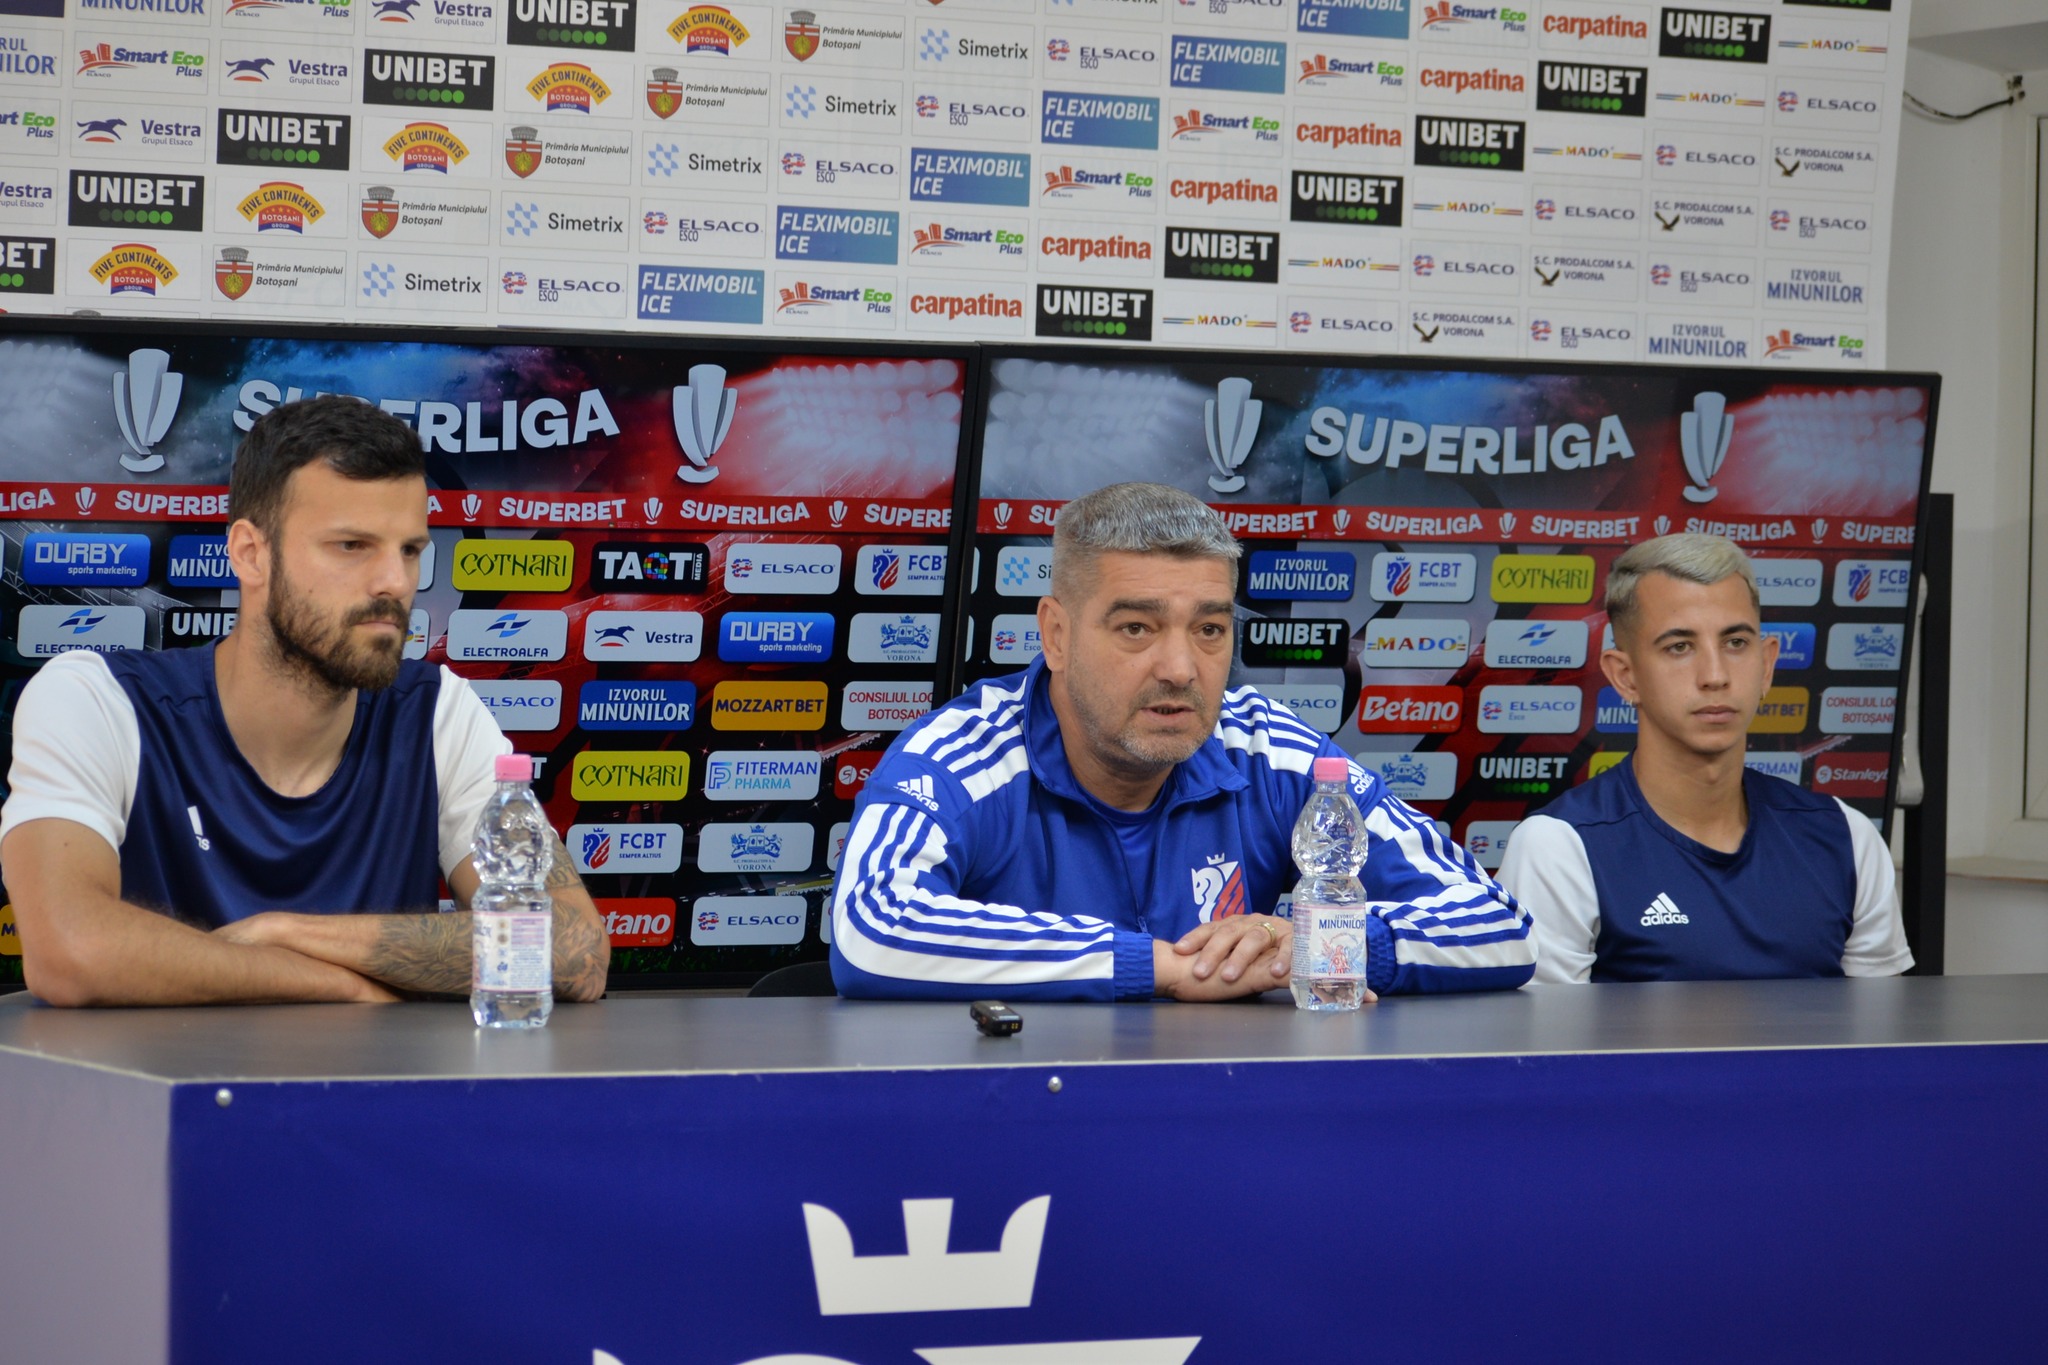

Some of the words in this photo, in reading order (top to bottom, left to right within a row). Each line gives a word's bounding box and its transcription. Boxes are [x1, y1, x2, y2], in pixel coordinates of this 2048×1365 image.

[434, 1, 492, 19] Vestra
[1543, 14, 1647, 40] carpatina
[1667, 13, 1765, 42] UNIBET
[113, 47, 168, 66] Smart
[172, 51, 204, 67] Eco
[958, 40, 1028, 60] Simetrix
[1079, 46, 1156, 62] ELSACO
[1173, 43, 1281, 67] FLEXIMOBIL
[176, 64, 202, 78] Plus
[288, 59, 348, 77] Vestra
[372, 54, 487, 87] UNIBET
[1173, 65, 1203, 83] ICE
[1329, 59, 1374, 76] Smart
[1377, 62, 1404, 76] Eco
[289, 76, 314, 86] Grupul
[317, 77, 340, 87] Elsaco
[1380, 74, 1403, 86] Plus
[1420, 67, 1524, 93] carpatina
[1544, 66, 1641, 95] UNIBET
[825, 96, 897, 117] Simetrix
[949, 102, 1026, 118] ELSACO
[1045, 98, 1153, 123] FLEXIMOBIL
[1807, 98, 1877, 113] ELSACO
[141, 119, 201, 138] Vestra
[225, 114, 342, 146] UNIBET
[1044, 119, 1073, 139] ICE
[1202, 113, 1248, 131] Smart
[1252, 117, 1279, 131] Eco
[141, 136, 167, 146] Grupul
[170, 137, 193, 147] Elsaco
[388, 136, 407, 155] FIVE
[409, 130, 464, 158] CONTINENTS
[1256, 129, 1279, 142] Plus
[1296, 123, 1401, 149] carpatina
[1421, 121, 1519, 150] UNIBET
[580, 143, 629, 156] Municipiului
[688, 154, 762, 175] Simetrix
[816, 160, 895, 176] ELSACO
[914, 154, 1025, 180] FLEXIMOBIL
[1685, 152, 1756, 166] ELSACO
[1804, 162, 1844, 173] VORONA
[913, 177, 943, 196] ICE
[1075, 169, 1121, 186] Smart
[1125, 172, 1153, 187] Eco
[77, 175, 196, 207] UNIBET
[1129, 185, 1152, 198] Plus
[1170, 179, 1278, 205] carpatina
[1298, 176, 1397, 205] UNIBET
[242, 196, 262, 215] FIVE
[263, 190, 319, 218] CONTINENTS
[401, 202, 438, 213] Primăria
[441, 203, 488, 215] Municipiului
[1565, 206, 1636, 221] ELSACO
[547, 212, 623, 234] Simetrix
[679, 219, 760, 234] ELSACO
[780, 213, 893, 236] FLEXIMOBIL
[1799, 217, 1868, 232] ELSACO
[779, 235, 809, 254] ICE
[944, 228, 993, 245] Smart
[995, 230, 1024, 246] Eco
[999, 243, 1024, 256] Plus
[1041, 234, 1151, 262] carpatina
[1171, 232, 1272, 262] UNIBET
[95, 258, 114, 277] FIVE
[116, 252, 172, 280] CONTINENTS
[256, 262, 297, 274] Primăria
[300, 264, 344, 277] Municipiului
[1443, 261, 1515, 277] ELSACO
[404, 273, 482, 294] Simetrix
[538, 278, 621, 294] ELSACO
[641, 272, 758, 296] FLEXIMOBIL
[1791, 269, 1843, 285] IZVORUL
[809, 285, 860, 303] Smart
[863, 288, 892, 303] Eco
[1767, 282, 1864, 305] MINUNILOR
[641, 294, 671, 314] ICE
[867, 301, 891, 314] Plus
[910, 293, 1023, 321] carpatina
[1042, 289, 1146, 319] UNIBET
[1321, 318, 1394, 333] ELSACO
[1433, 312, 1490, 326] PRODALCOM
[1443, 326, 1485, 338] VORONA
[1672, 323, 1726, 340] IZVORUL
[1649, 336, 1747, 360] MINUNILOR
[1792, 333, 1835, 349] Smart
[1838, 336, 1863, 350] Eco
[1842, 348, 1863, 360] Plus
[1305, 405, 1635, 476] SUPERLIGA
[500, 497, 627, 524] SUPERBET
[680, 500, 810, 527] SUPERLIGA
[1366, 511, 1483, 537] SUPERLIGA
[1530, 515, 1640, 539] SUPERBET
[35, 541, 128, 566] DURBY
[68, 567, 94, 577] sports
[96, 566, 137, 577] marketing
[694, 553, 703, 581] MEDIA
[761, 563, 833, 575] ELSACO
[1275, 558, 1328, 571] IZVORUL
[1420, 562, 1462, 578] FCBT
[1249, 571, 1350, 592] MINUNILOR
[645, 631, 693, 645] Vestra
[730, 621, 814, 643] DURBY
[1250, 623, 1342, 646] UNIBET
[463, 647, 549, 659] ELECTROALFA
[760, 643, 785, 653] sports
[787, 642, 822, 653] marketing
[1023, 643, 1041, 652] Esco
[1378, 637, 1457, 651] MADO
[886, 653, 922, 663] VORONA
[1498, 654, 1571, 665] ELECTROALFA
[608, 688, 668, 702] IZVORUL
[849, 692, 910, 703] CONSILIUL
[1826, 697, 1878, 707] CONSILIUL
[580, 701, 692, 723] MINUNILOR
[1362, 696, 1459, 722] Betano
[1509, 701, 1575, 711] ELSACO
[1509, 713, 1525, 721] Esco
[737, 762, 817, 775] FITERMAN
[1480, 758, 1568, 779] UNIBET
[735, 778, 791, 789] PHARMA
[620, 834, 666, 849] FCBT
[737, 863, 772, 871] VORONA
[727, 916, 799, 926] ELSACO
[1319, 919, 1365, 929] MINUNILOR
[1640, 904, 1689, 926] adidas
